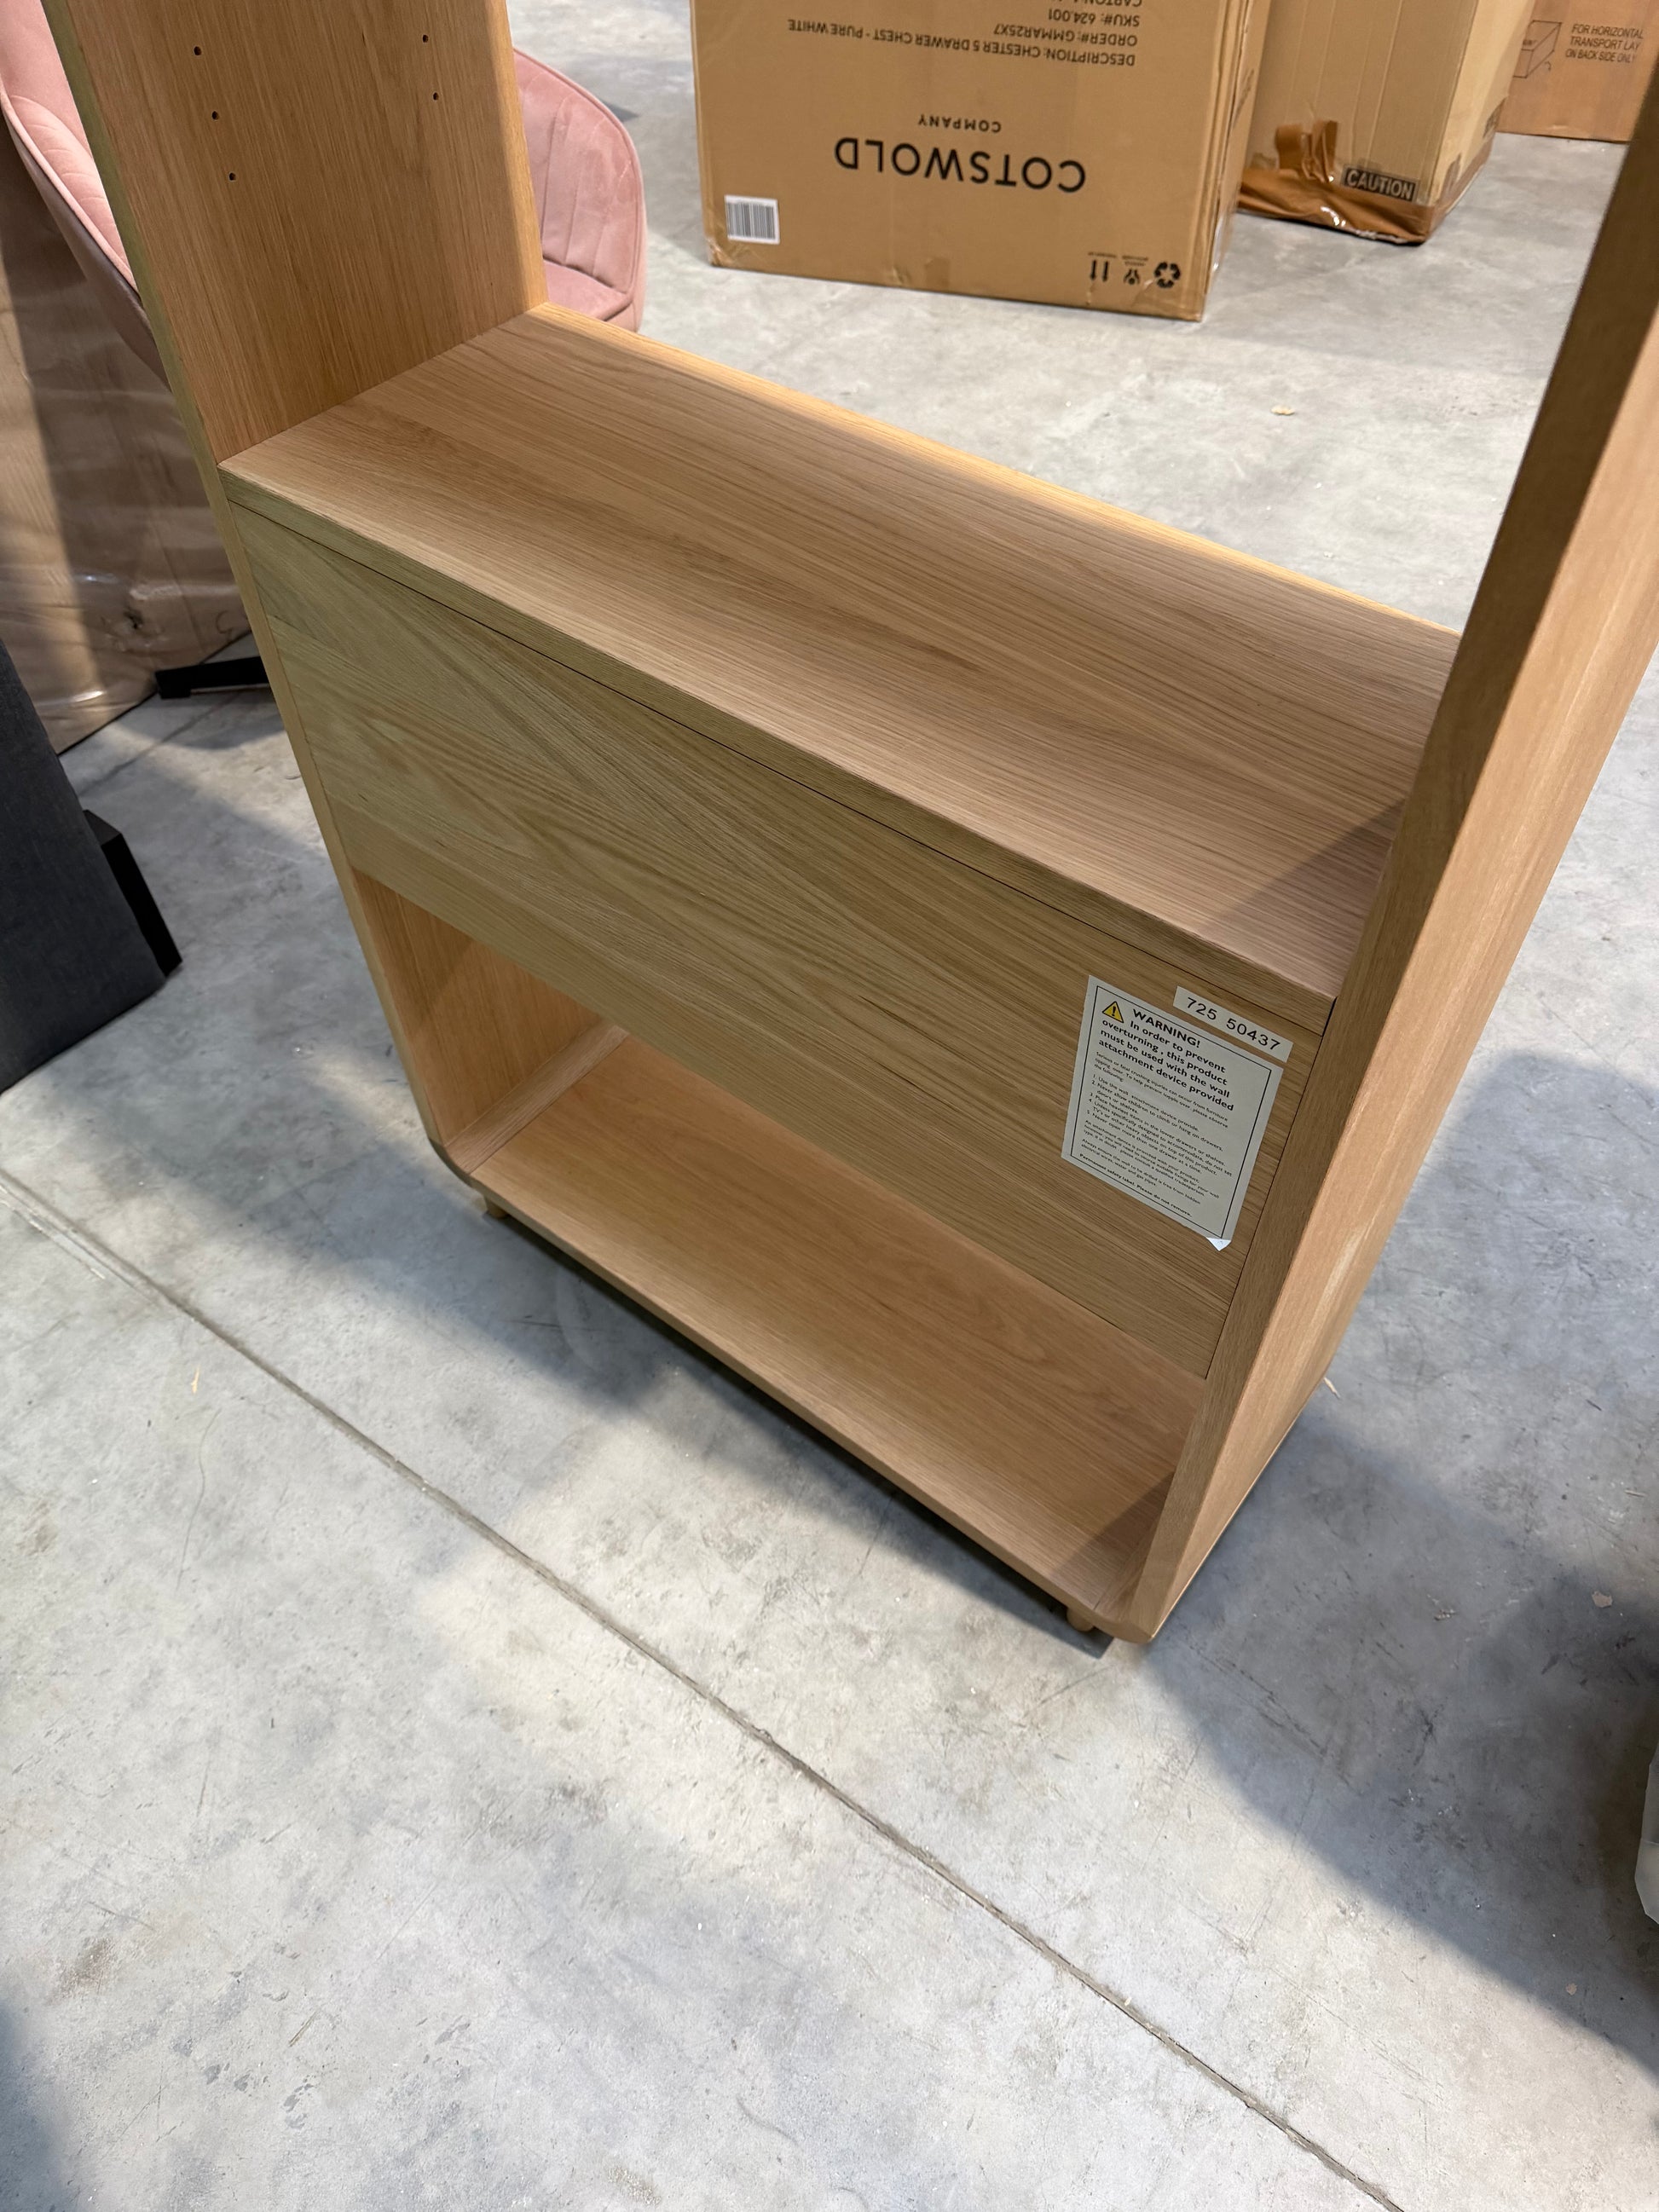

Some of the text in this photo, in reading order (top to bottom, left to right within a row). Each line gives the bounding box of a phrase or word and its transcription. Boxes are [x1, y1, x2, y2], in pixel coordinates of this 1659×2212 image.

[787, 19, 830, 35] WHITE
[1048, 8, 1141, 27] SKU#: 624.001
[830, 23, 864, 39] PURE
[873, 29, 914, 45] CHEST
[993, 22, 1075, 43] GMMAR25X7
[1571, 23, 1645, 39] FOR HORIZONTAL
[914, 34, 970, 51] DRAWER
[973, 39, 980, 51] 5
[984, 39, 1041, 58] CHESTER
[1569, 36, 1642, 51] TRANSPORT LAY
[1043, 47, 1136, 66] DESCRIPTION:
[1565, 48, 1637, 64] ON BACK SIDE ONLY
[917, 113, 1003, 134] COMPANY
[834, 136, 1087, 193] COTSWOLD
[1345, 170, 1413, 201] CAUTION
[1132, 1008, 1200, 1048] WARNING!
[1186, 996, 1281, 1051] 725 50437
[1101, 1019, 1159, 1053] overturning
[1166, 1050, 1185, 1065] this
[1186, 1061, 1228, 1086] product
[1130, 1019, 1226, 1073] In order to prevent
[1100, 1029, 1230, 1098] must be used with the wall
[1098, 1039, 1234, 1112] attachment device provided
